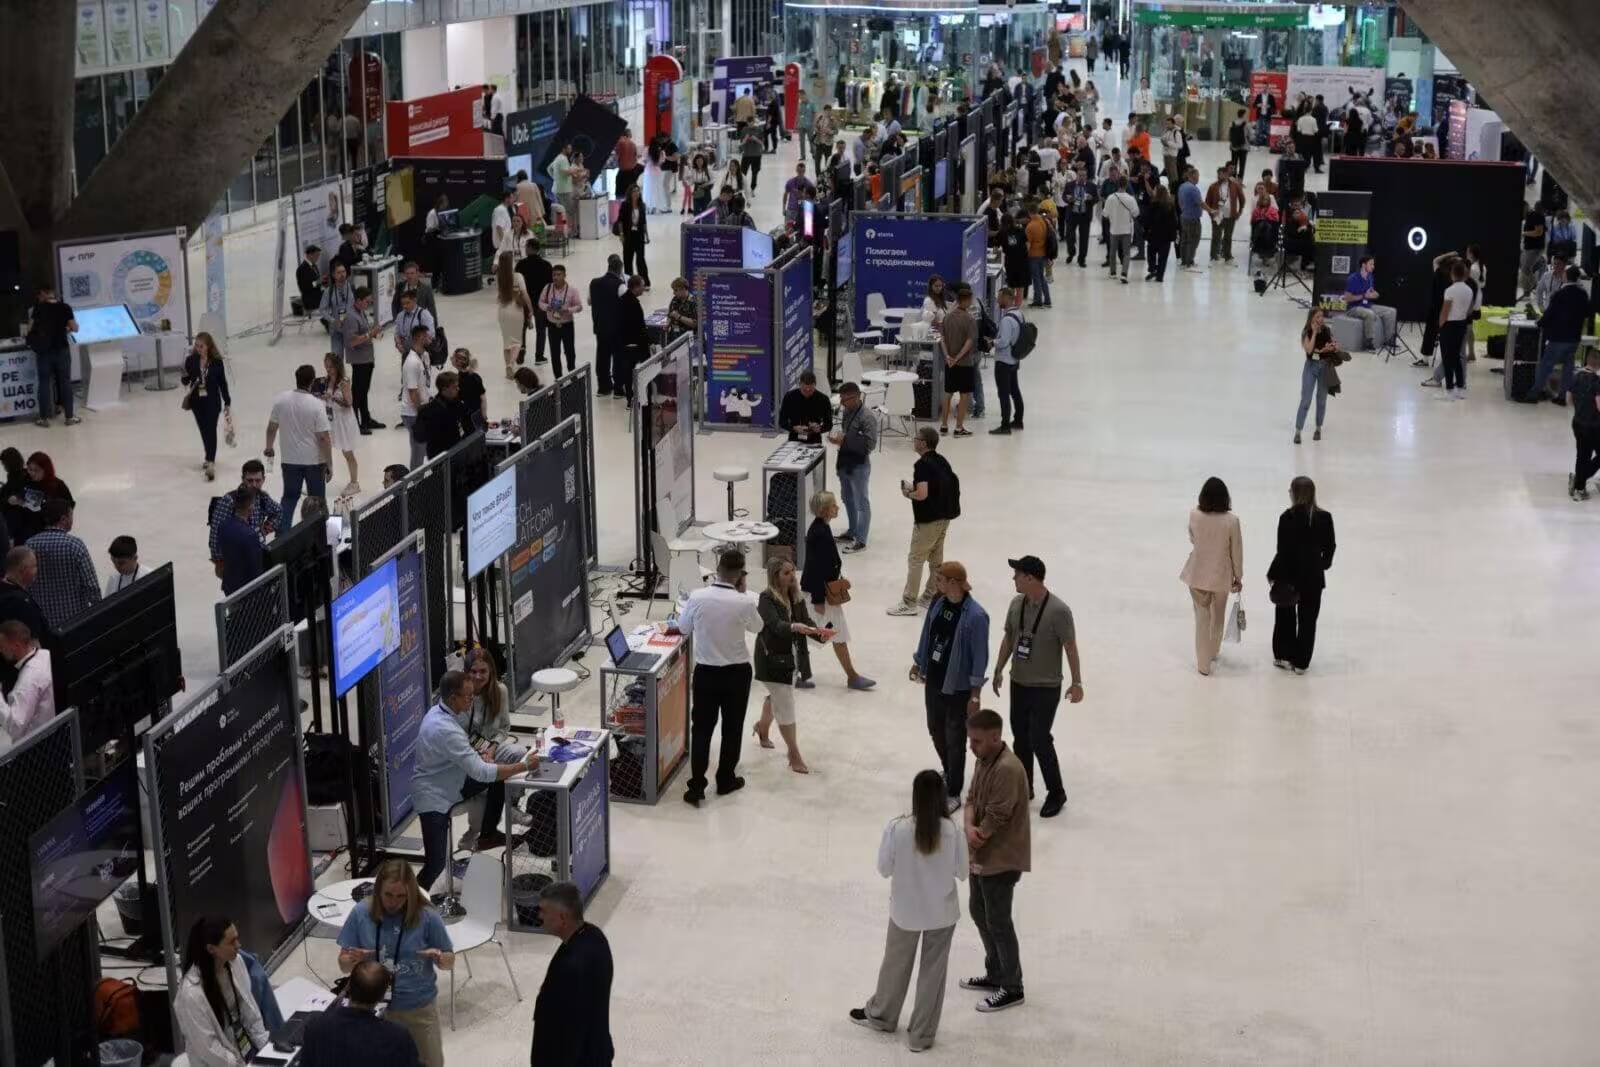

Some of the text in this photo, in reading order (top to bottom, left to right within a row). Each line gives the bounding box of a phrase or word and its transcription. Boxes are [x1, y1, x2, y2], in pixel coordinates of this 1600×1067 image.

[78, 252, 95, 261] ППР
[865, 247, 907, 257] Помогаем
[872, 258, 935, 268] продвижением
[8, 355, 28, 366] ППР
[2, 371, 19, 383] РЕ
[3, 384, 34, 397] ШАЕ
[14, 398, 36, 411] МО
[179, 768, 205, 797] Решим
[206, 738, 243, 774] проблемы
[247, 704, 280, 739] качеством
[178, 791, 203, 820] ваших
[203, 751, 253, 800] программных
